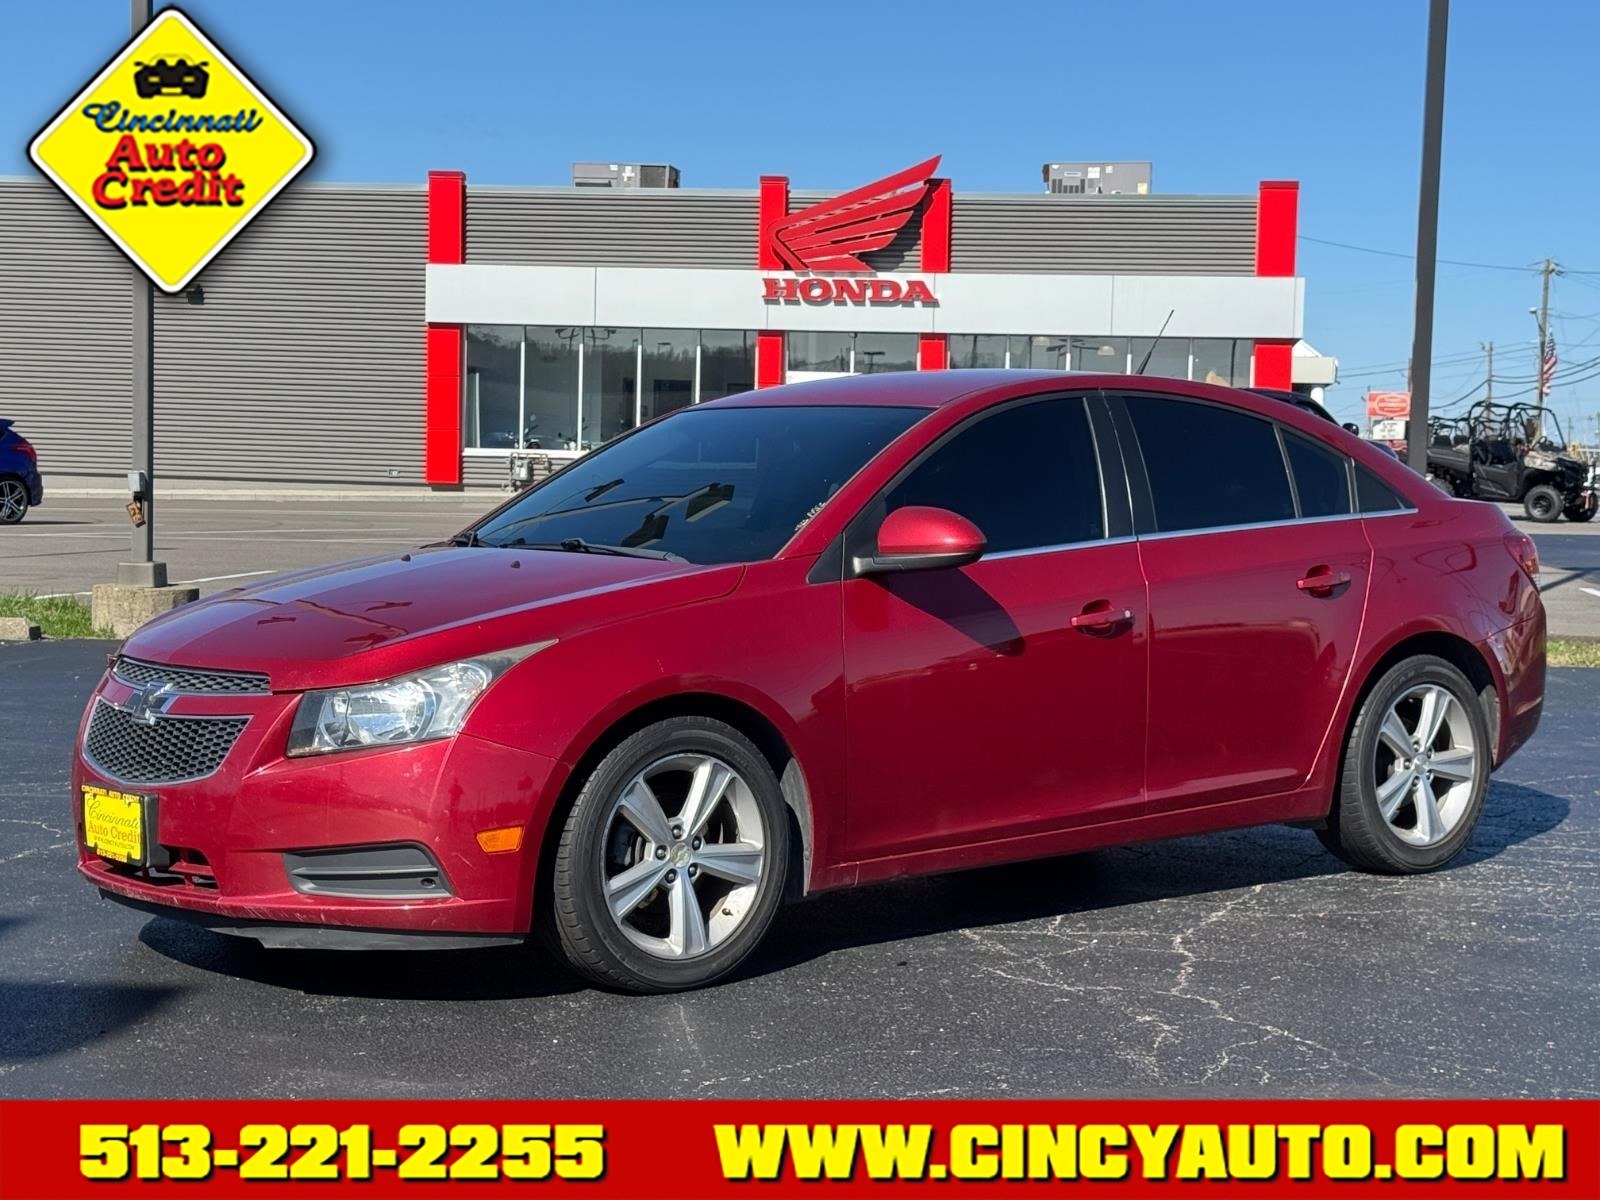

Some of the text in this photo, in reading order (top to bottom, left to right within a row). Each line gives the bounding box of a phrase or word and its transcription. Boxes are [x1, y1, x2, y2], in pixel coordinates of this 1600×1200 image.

[762, 278, 939, 307] HONDA
[87, 798, 139, 829] Cincinnati
[88, 820, 108, 837] Auto
